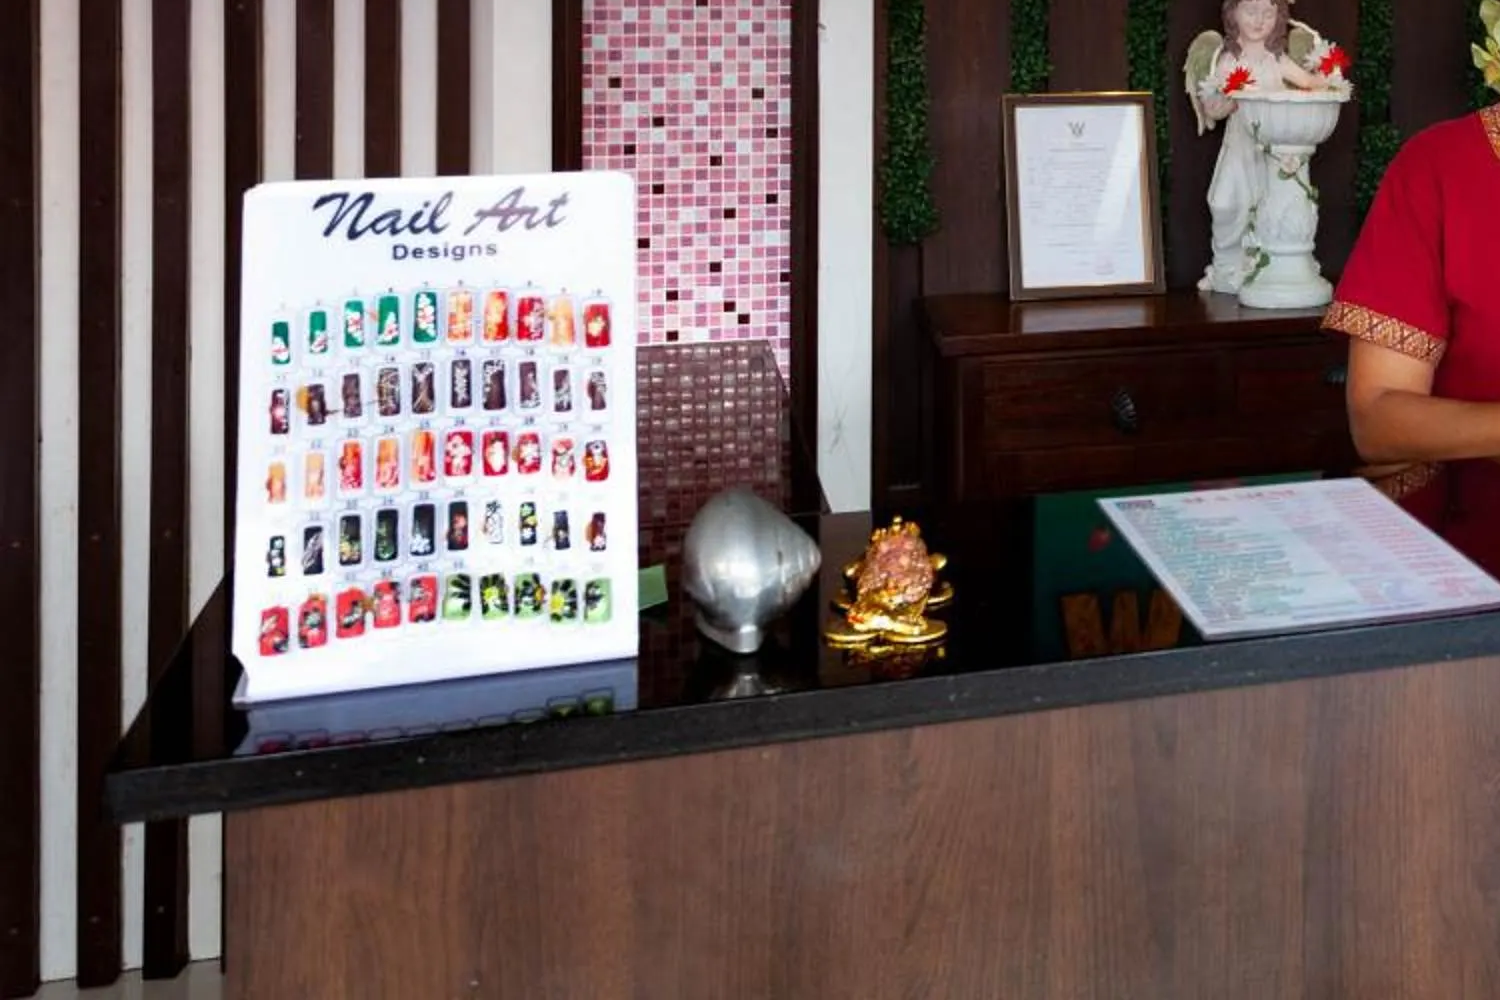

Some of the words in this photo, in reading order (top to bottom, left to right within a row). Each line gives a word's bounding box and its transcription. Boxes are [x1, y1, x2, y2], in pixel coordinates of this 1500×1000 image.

[312, 190, 454, 240] Nail
[463, 185, 571, 236] Art
[392, 242, 498, 261] Designs
